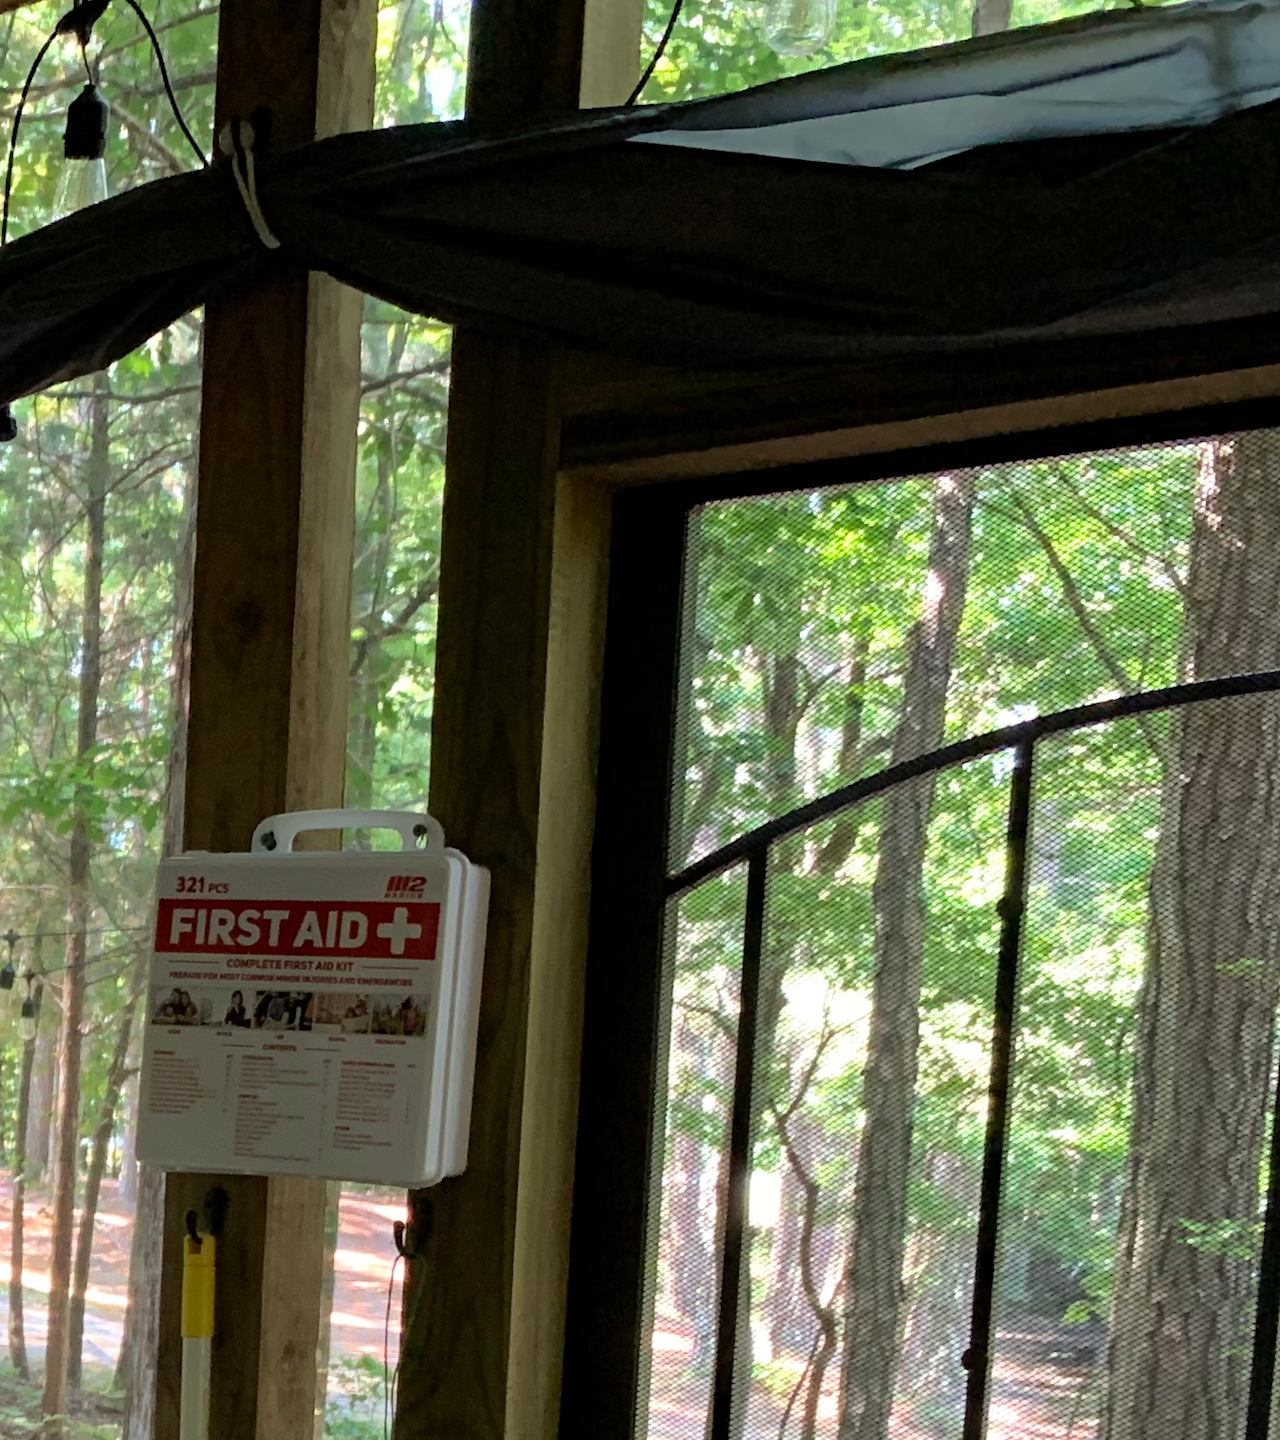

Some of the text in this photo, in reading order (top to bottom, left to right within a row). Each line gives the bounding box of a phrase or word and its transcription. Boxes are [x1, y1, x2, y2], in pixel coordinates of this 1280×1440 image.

[176, 876, 230, 894] 321 PCS
[169, 907, 369, 949] FIRST AID
[226, 958, 354, 972] COMPLETE FIRST AID KIT
